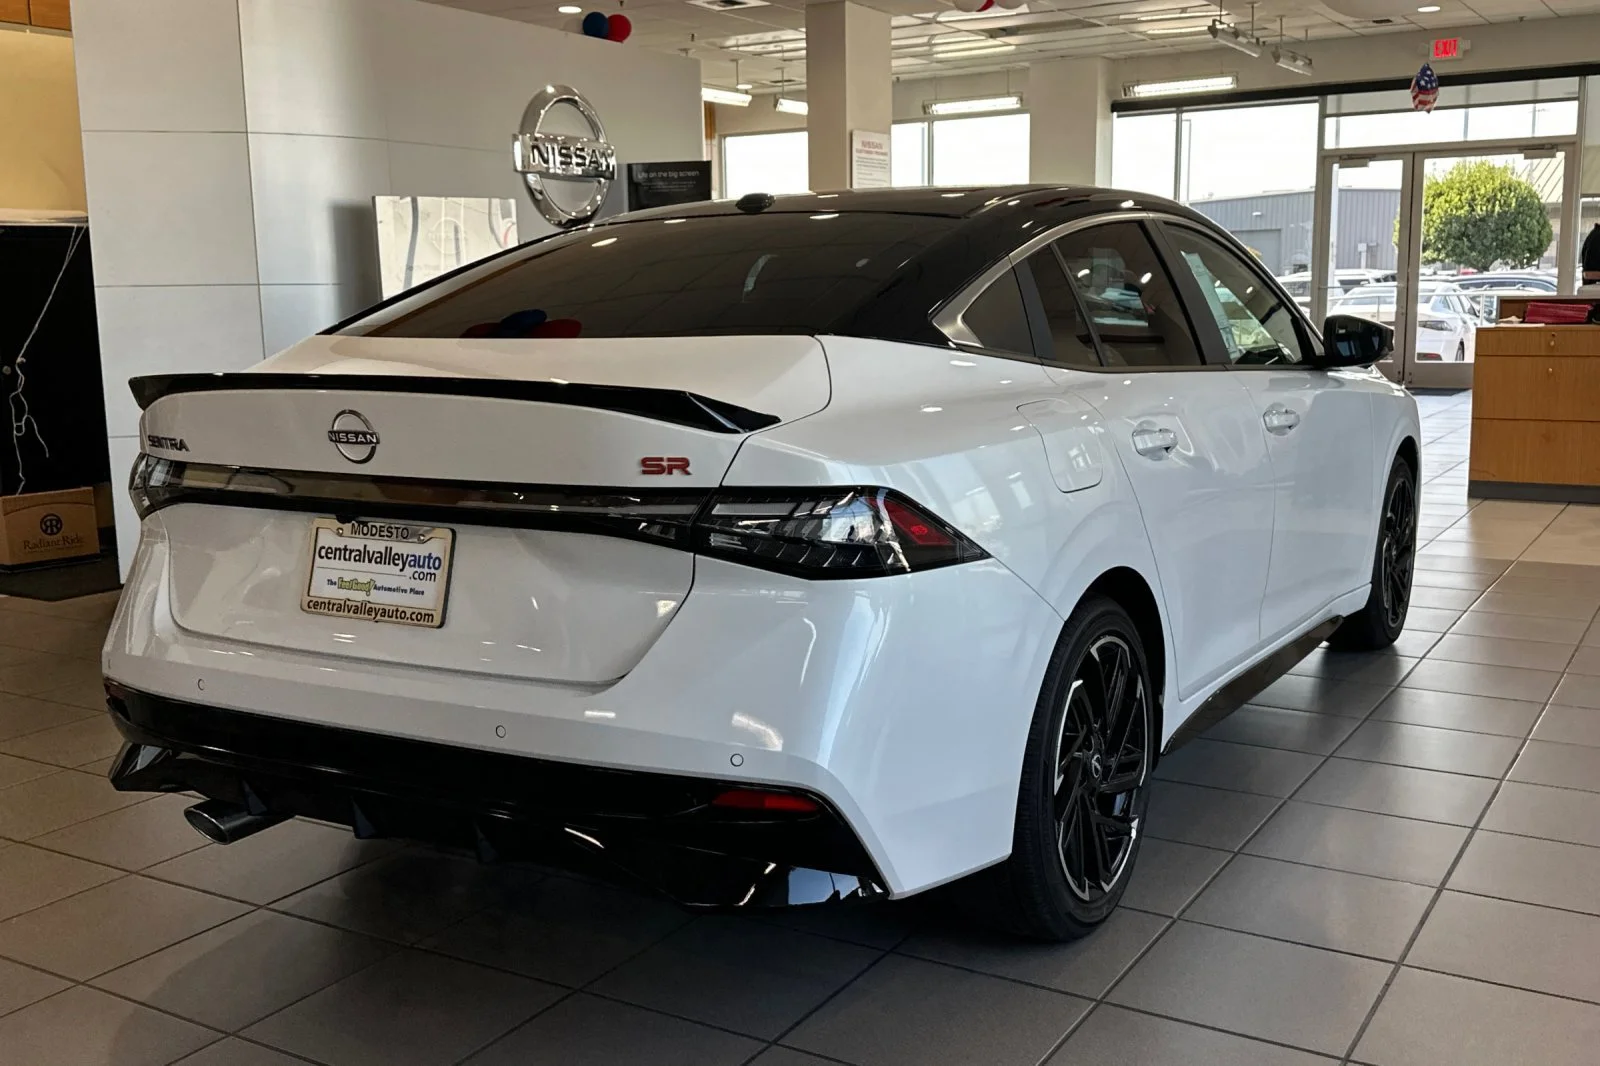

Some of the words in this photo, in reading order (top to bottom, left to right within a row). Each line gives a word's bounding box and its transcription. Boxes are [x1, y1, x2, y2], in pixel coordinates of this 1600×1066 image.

[1434, 39, 1457, 57] EXIT
[531, 142, 615, 172] NISSAN
[668, 170, 679, 178] big
[329, 432, 378, 443] NISSAN
[641, 456, 692, 475] SR
[351, 523, 409, 539] MODESTO
[318, 544, 441, 572] centralvalleyauto
[409, 570, 436, 582] .com
[373, 584, 408, 594] Automotive
[409, 588, 425, 596] Place
[307, 599, 434, 623] centralvalleyauto.com
